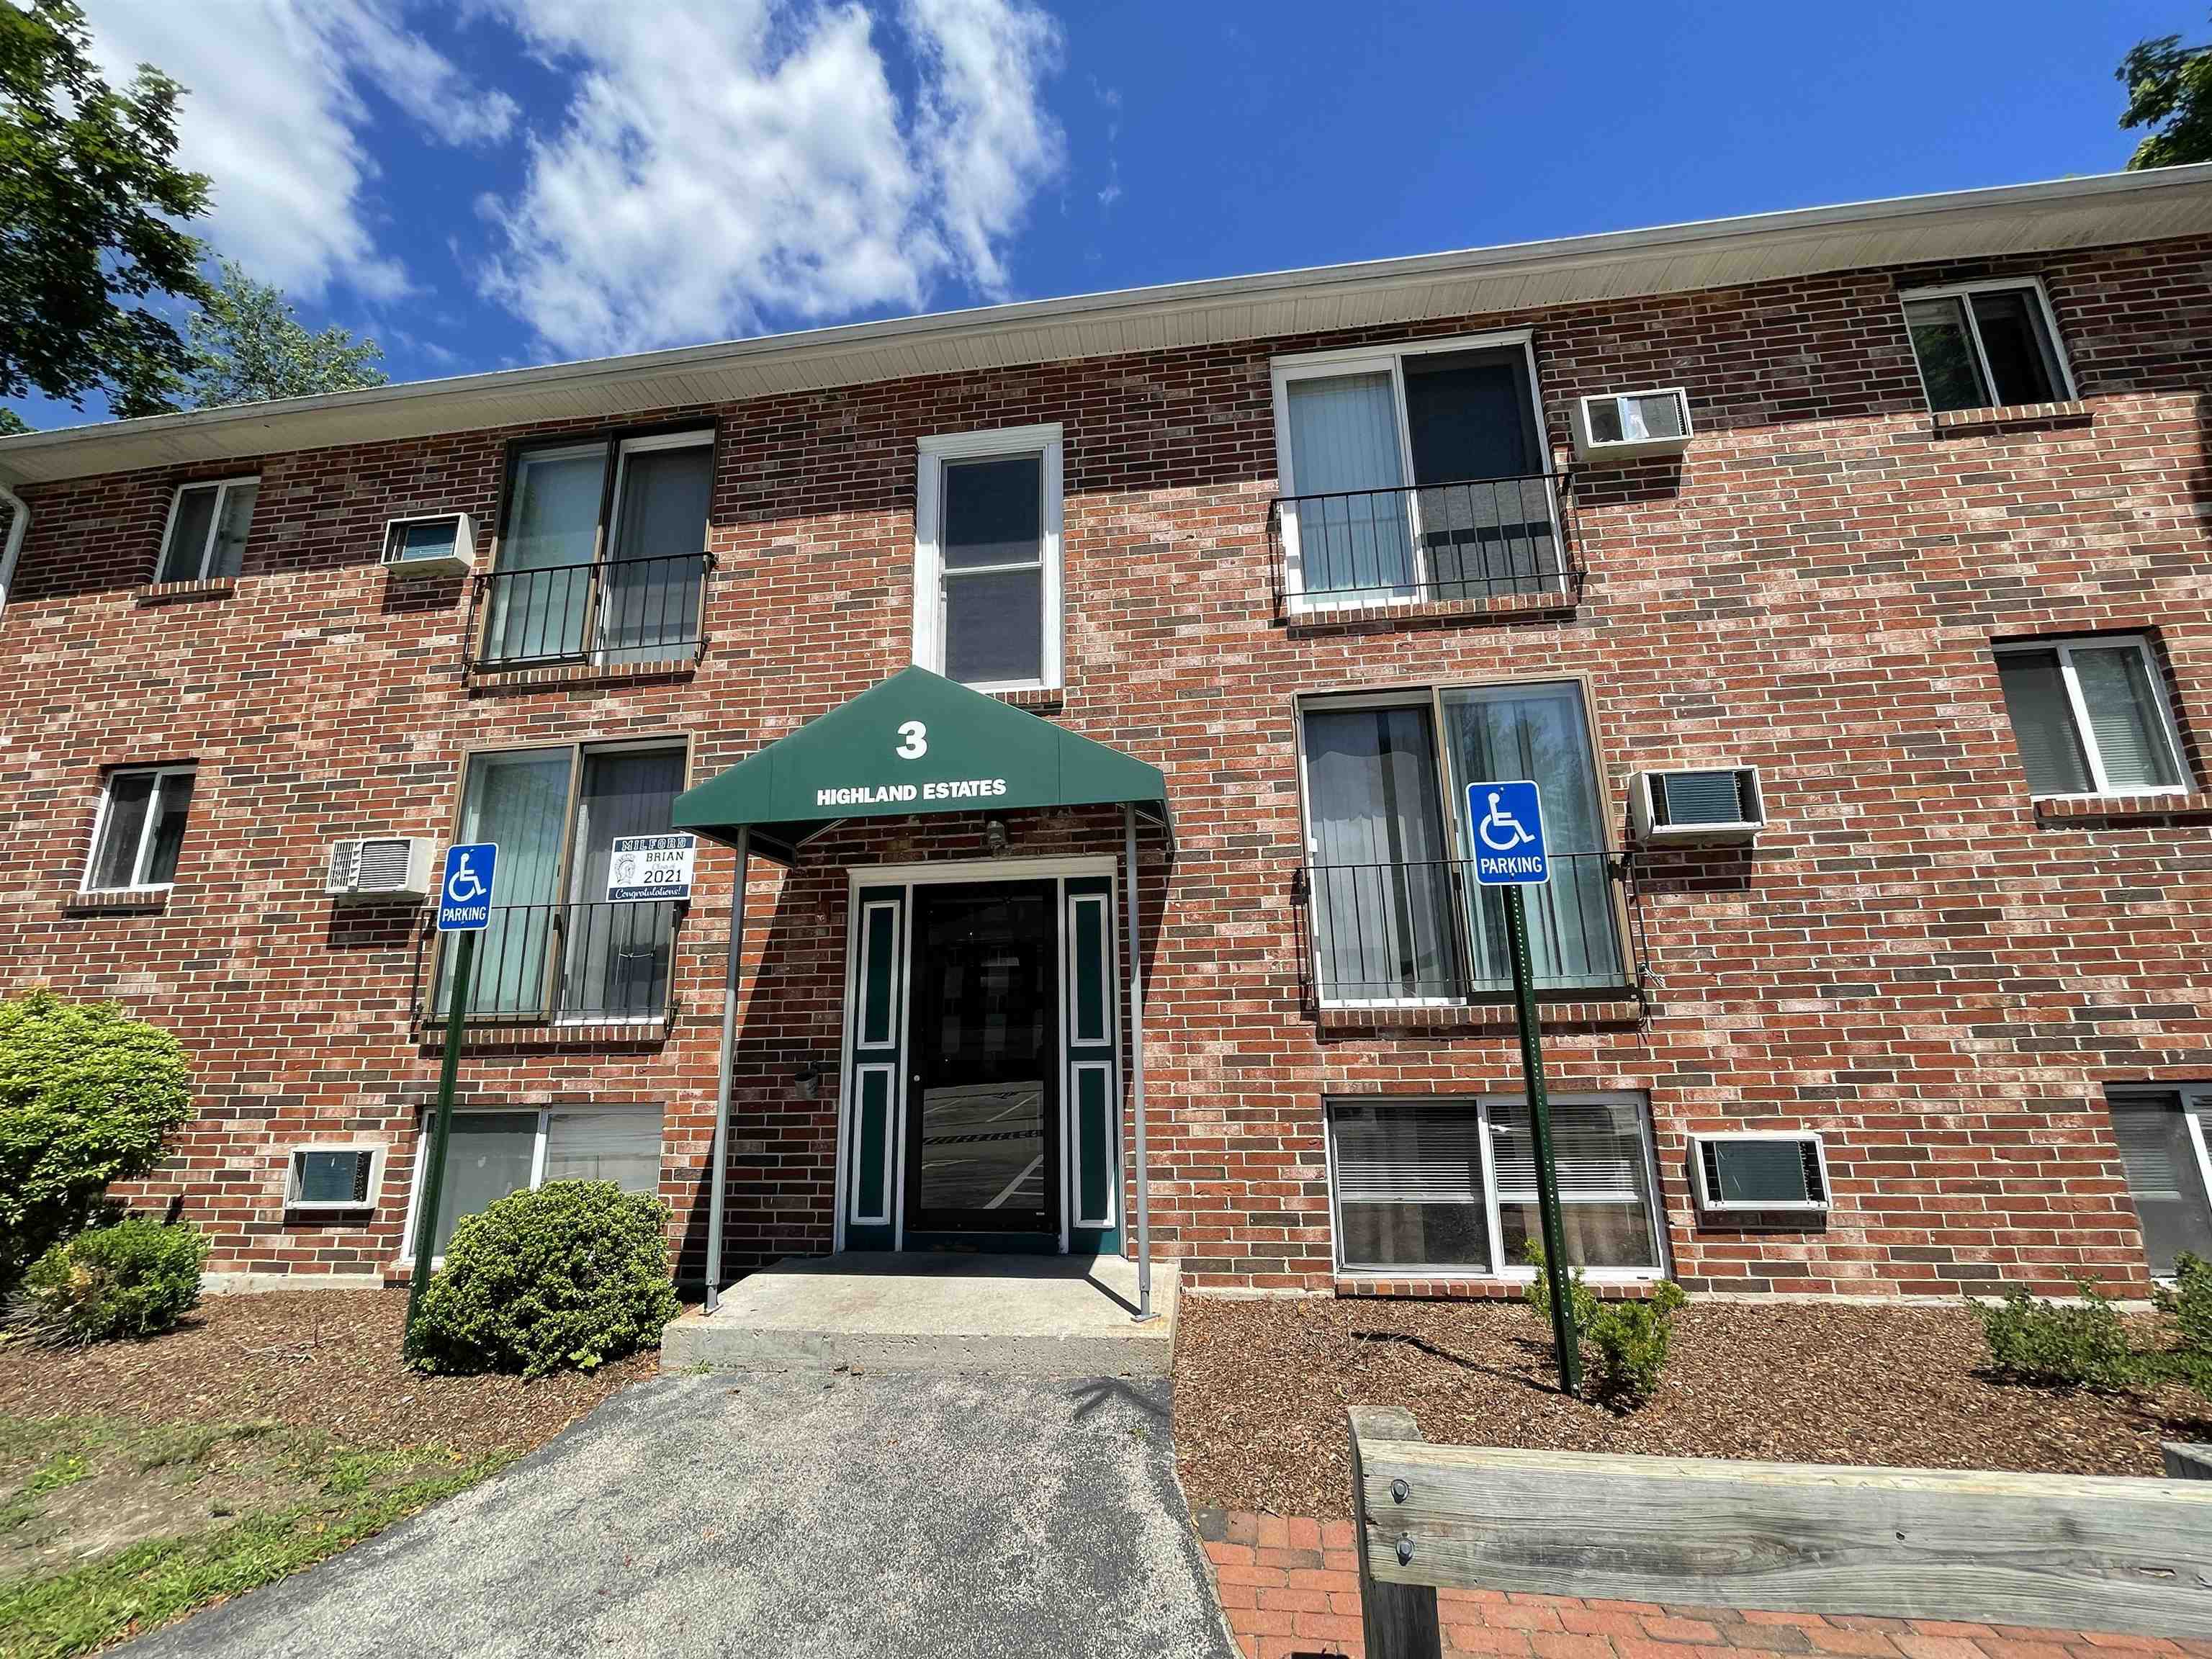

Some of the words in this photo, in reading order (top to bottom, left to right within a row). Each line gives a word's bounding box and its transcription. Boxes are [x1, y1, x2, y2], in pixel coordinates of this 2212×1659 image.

[896, 720, 927, 760] 3
[817, 785, 917, 806] HIGHLAND
[922, 778, 1007, 799] ESTATES
[621, 837, 686, 850] MILFORD
[646, 851, 684, 862] BRIAN
[1481, 856, 1542, 874] PARKING
[644, 870, 681, 884] 2021
[615, 886, 681, 899] Congratulations!
[442, 907, 486, 922] PARKING
